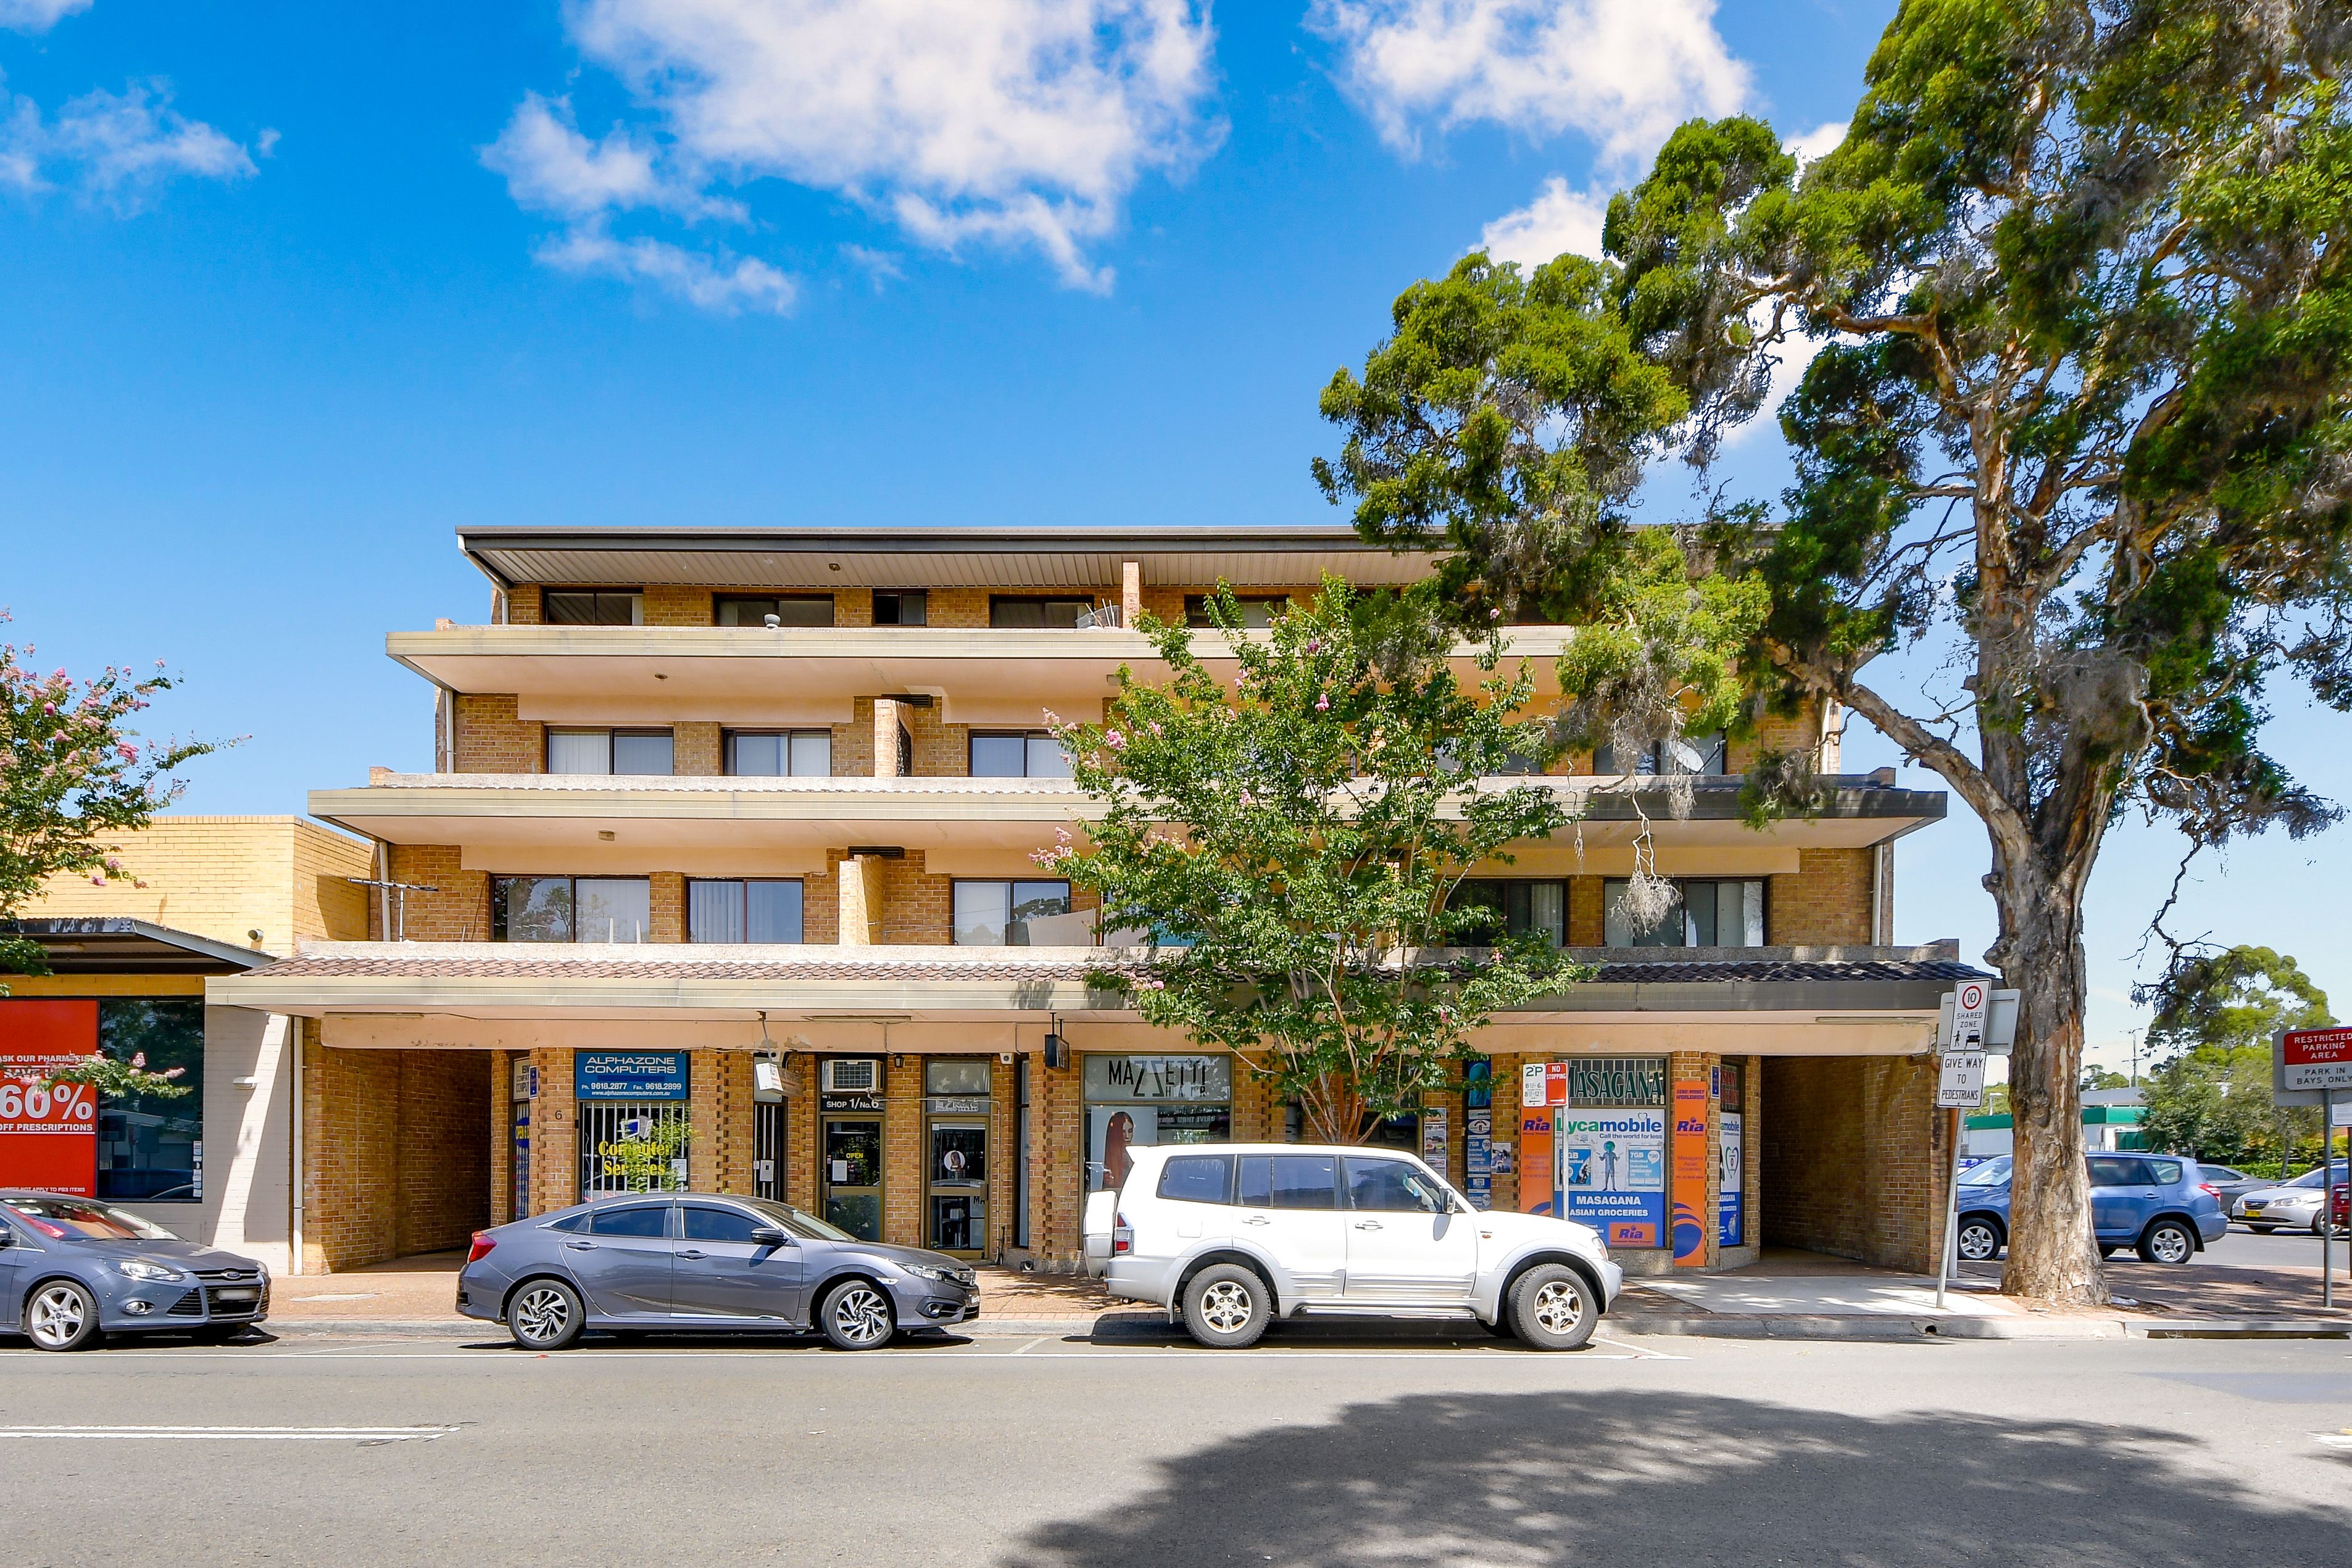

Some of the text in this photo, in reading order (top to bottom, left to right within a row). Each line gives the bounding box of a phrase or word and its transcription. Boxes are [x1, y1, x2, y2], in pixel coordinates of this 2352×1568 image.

[1968, 992, 1976, 1003] 10
[1956, 1011, 1982, 1019] SHARED
[2294, 1033, 2352, 1044] RESTRICTED
[2303, 1042, 2345, 1052] PARKING
[586, 1056, 675, 1065] ALPHAZONE
[2311, 1052, 2338, 1060] AREA
[1945, 1057, 1984, 1069] GIVE WAY
[584, 1066, 676, 1074] COMPUTERS
[1526, 1066, 1543, 1077] 2P
[2304, 1068, 2330, 1076] PARK
[1957, 1074, 1967, 1084] TO
[2296, 1075, 2352, 1085] BAYS ONLY
[1942, 1089, 1979, 1100] PEDESTRIANS
[0, 1084, 93, 1120] 60%
[555, 1110, 562, 1120] 6
[1523, 1116, 1550, 1131] Ria
[1676, 1117, 1704, 1132] Ria
[599, 1141, 670, 1156] Couter
[604, 1160, 666, 1176] Serces
[1576, 1195, 1642, 1205] MASAGANA
[1598, 1209, 1648, 1217] GROCERIES
[1619, 1226, 1643, 1239] Ria
